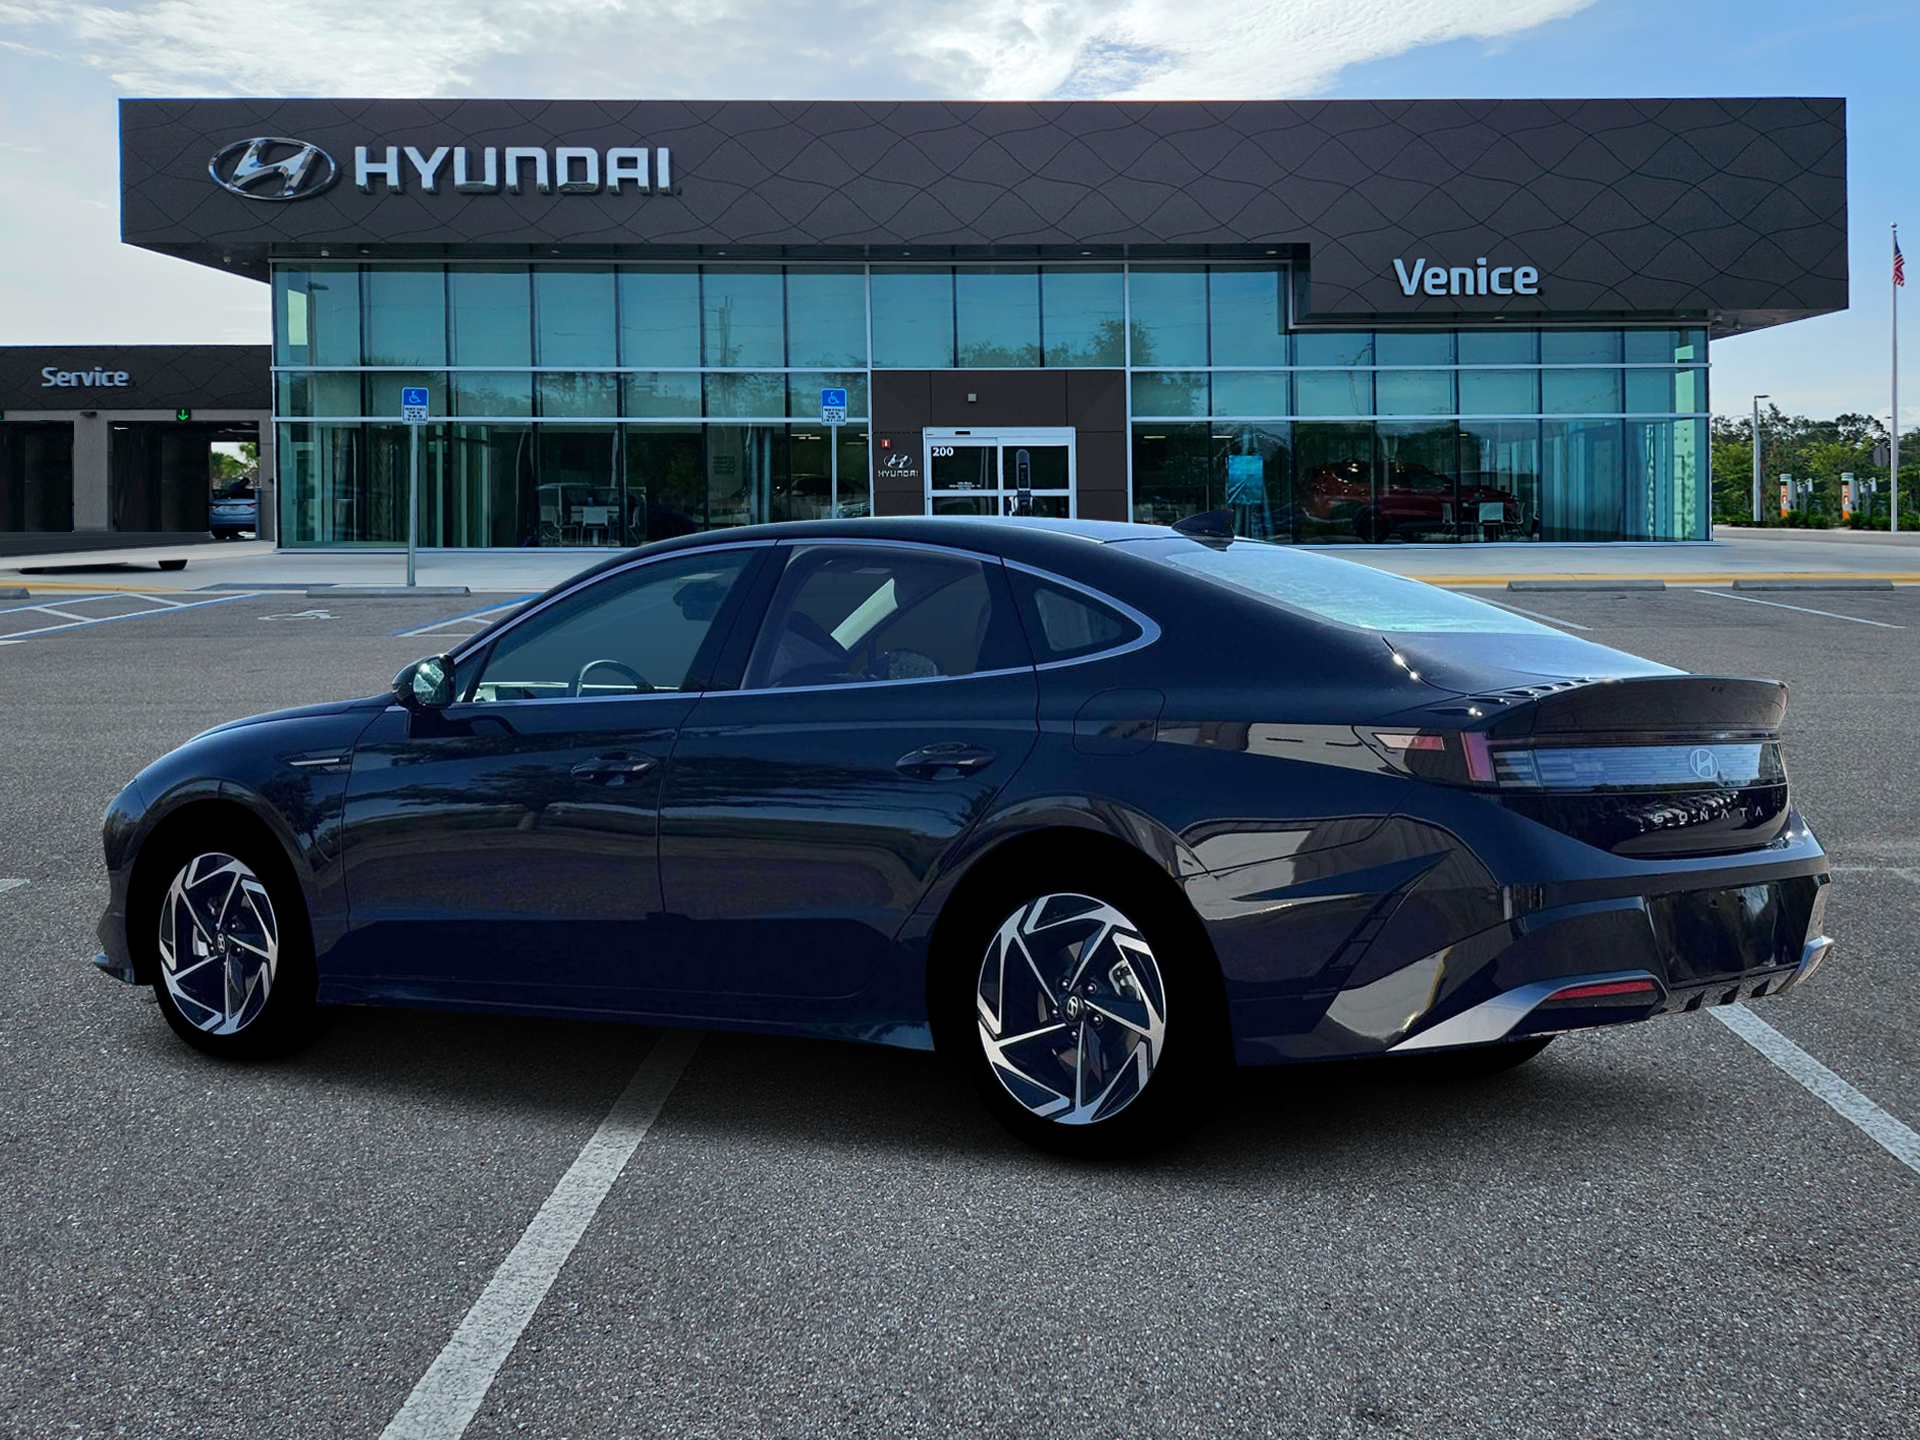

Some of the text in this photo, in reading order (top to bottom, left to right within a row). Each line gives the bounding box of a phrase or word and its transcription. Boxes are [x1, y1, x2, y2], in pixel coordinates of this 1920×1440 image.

[354, 146, 673, 194] HYUNDAI
[1392, 257, 1539, 296] Venice
[41, 366, 130, 388] Service
[932, 446, 954, 457] 200
[877, 469, 919, 478] HYUNDAI
[1652, 805, 1764, 825] SONATA
